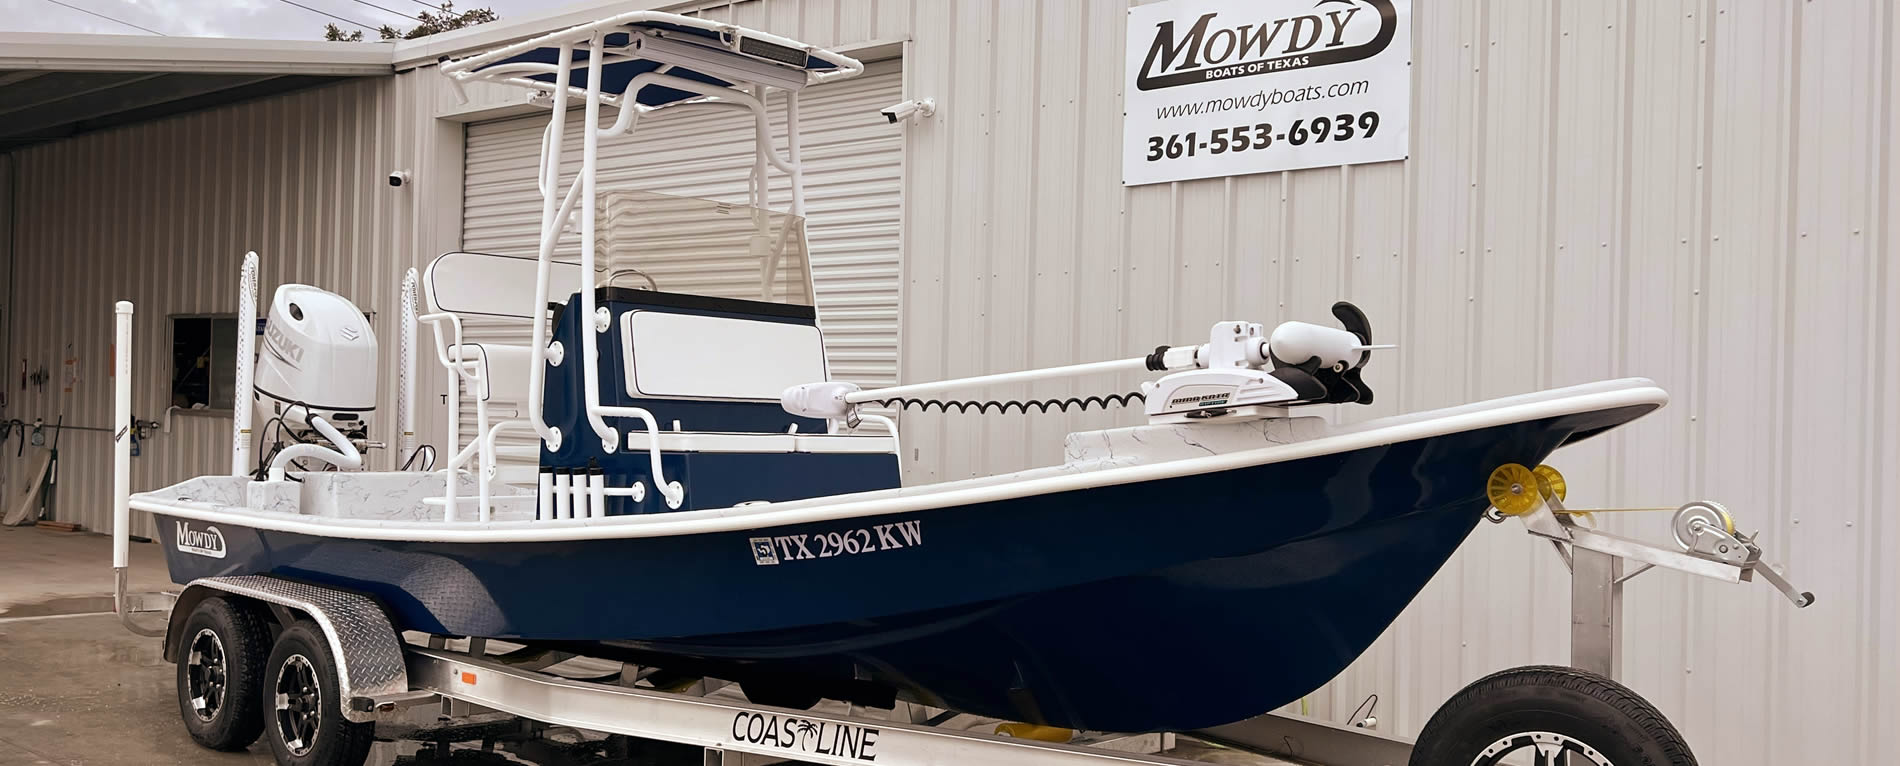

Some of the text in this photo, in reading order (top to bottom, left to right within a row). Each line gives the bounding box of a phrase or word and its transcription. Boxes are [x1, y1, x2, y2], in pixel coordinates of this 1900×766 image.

[1205, 56, 1309, 80] BOATS OF TEXAS
[1156, 80, 1369, 119] www.mowdyboats.com
[1146, 111, 1380, 162] 361-553-6939
[774, 534, 816, 561] TX
[813, 529, 876, 558] 2962
[873, 520, 922, 550] KW
